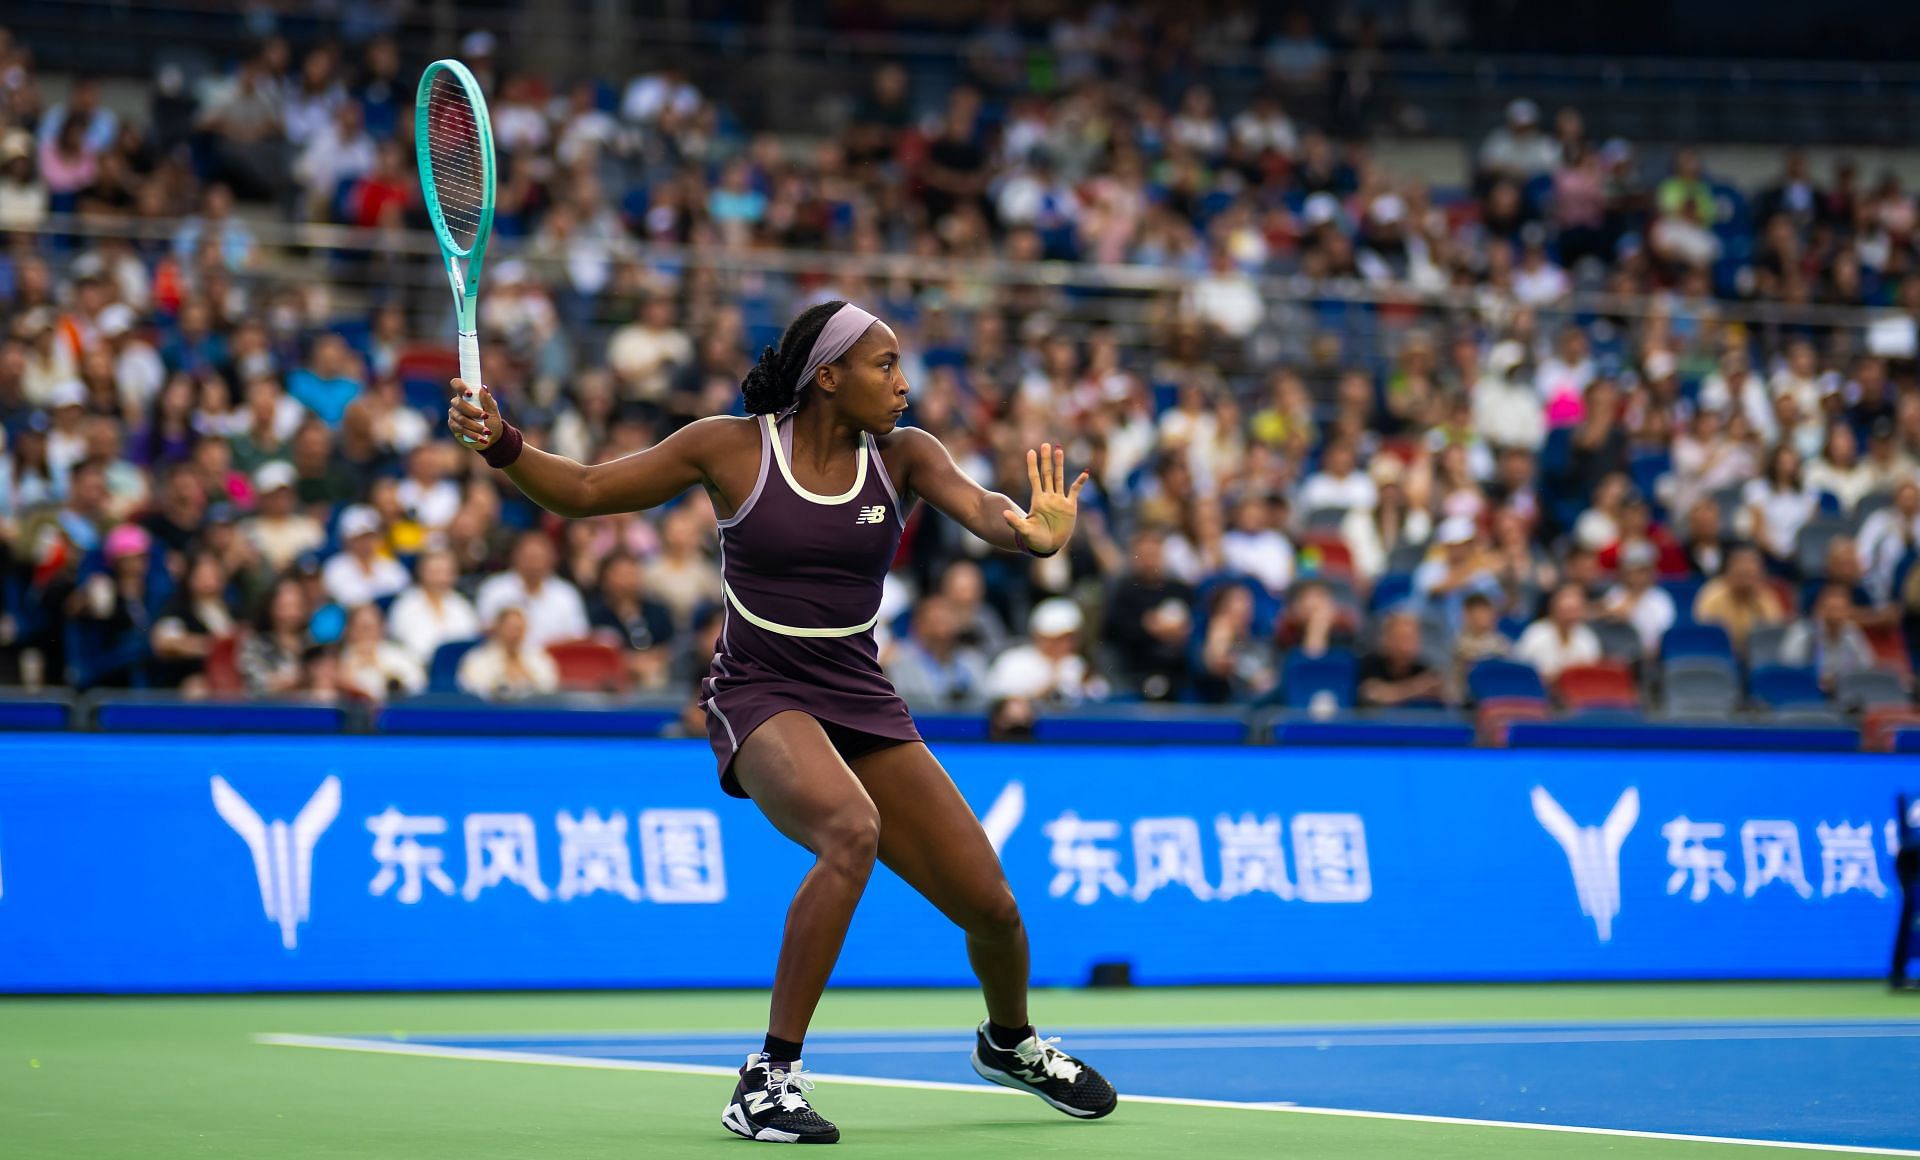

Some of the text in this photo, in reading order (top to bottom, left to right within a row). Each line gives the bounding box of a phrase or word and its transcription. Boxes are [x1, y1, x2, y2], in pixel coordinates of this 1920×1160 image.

[366, 807, 727, 904] 东风岚图
[1044, 811, 1373, 905] 东风岚图
[1661, 815, 1898, 902] 东风岚
[743, 1090, 775, 1115] N
